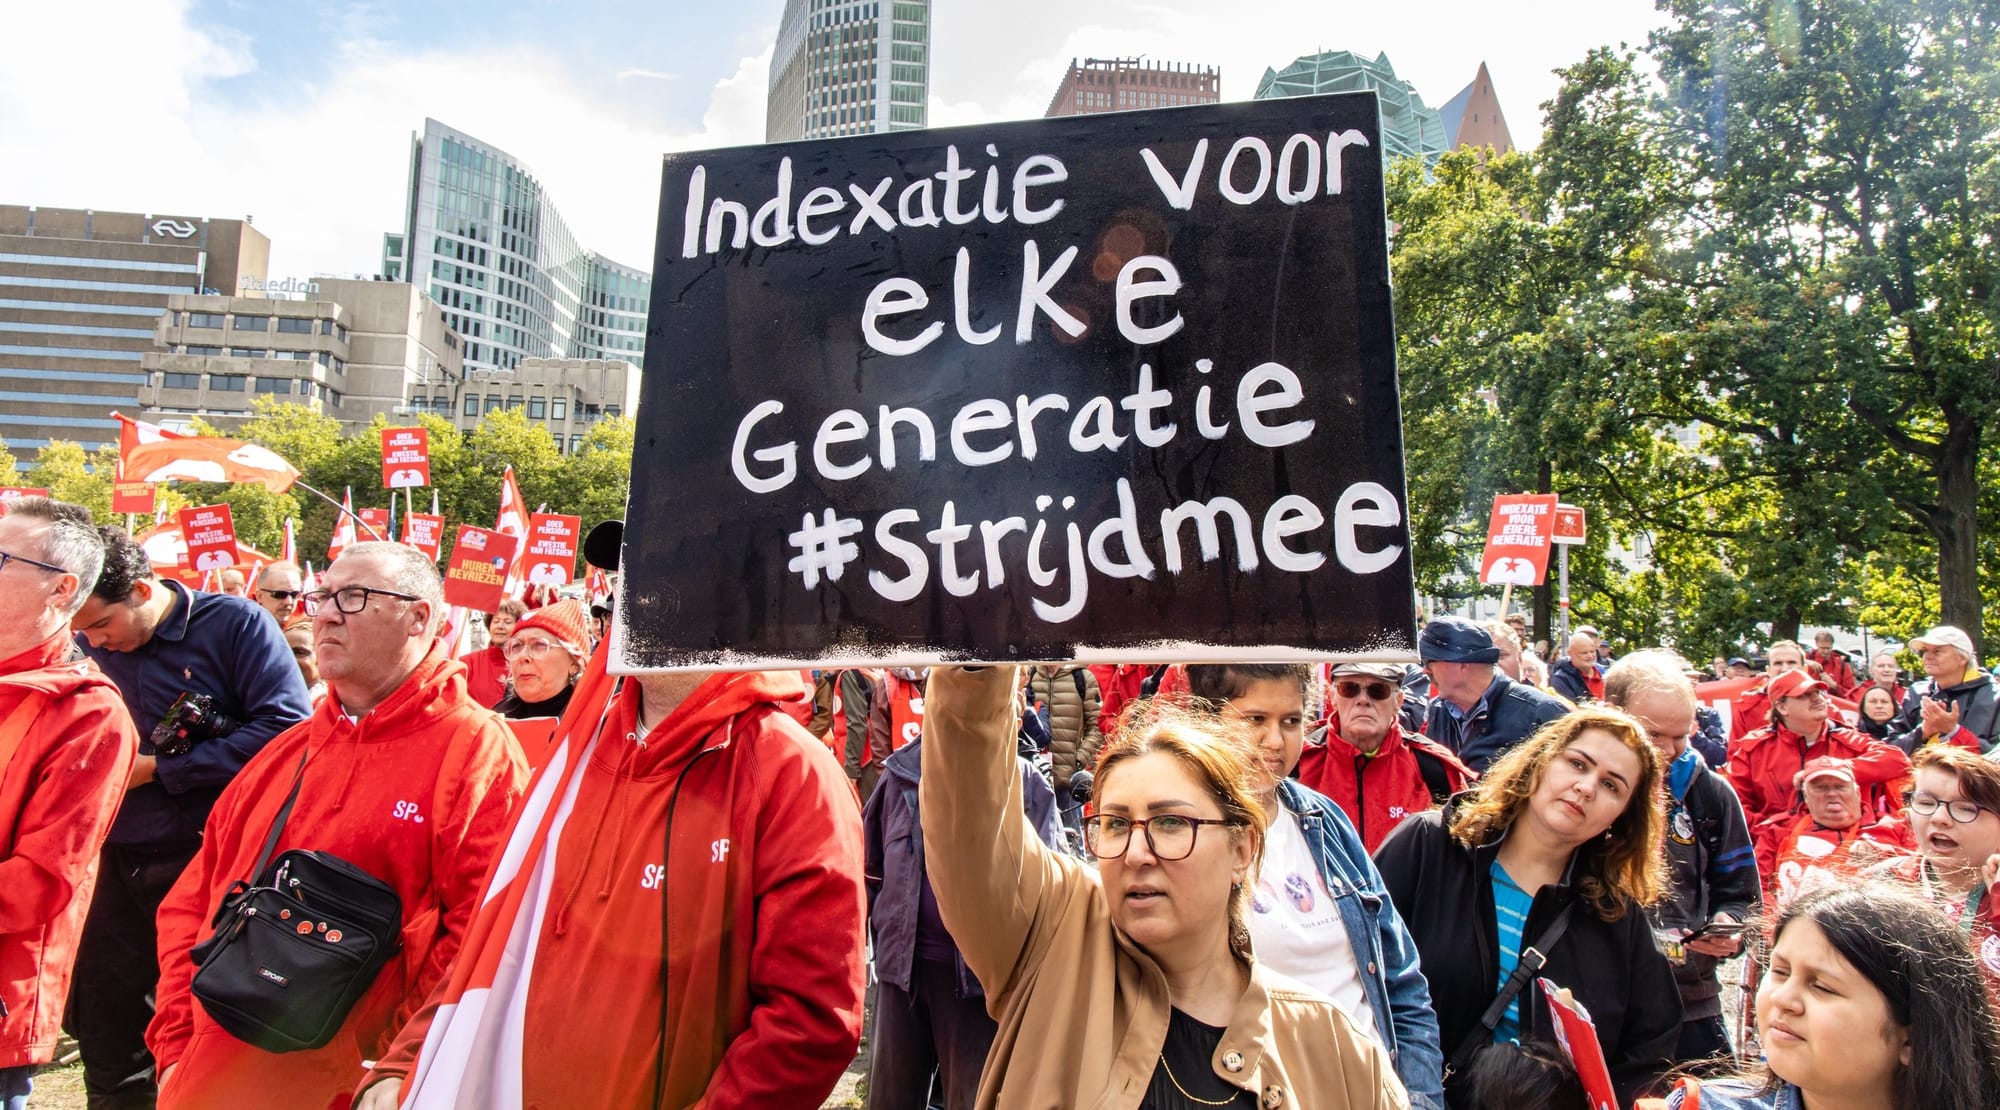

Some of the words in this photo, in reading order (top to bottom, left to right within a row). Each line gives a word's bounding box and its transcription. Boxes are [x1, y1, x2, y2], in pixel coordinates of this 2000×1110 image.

[682, 143, 1068, 259] Indexatie
[240, 275, 319, 293] Staedion
[732, 358, 1316, 493] Generatie
[1499, 503, 1549, 515] INDEXATIE
[1508, 514, 1535, 525] VOOR
[1502, 524, 1538, 535] IEDERE
[1491, 535, 1545, 547] GENERATIE
[461, 559, 497, 574] HUREN
[448, 567, 504, 586] BEVRIEZEN
[711, 838, 730, 864] SP
[262, 969, 284, 983] SPORT
